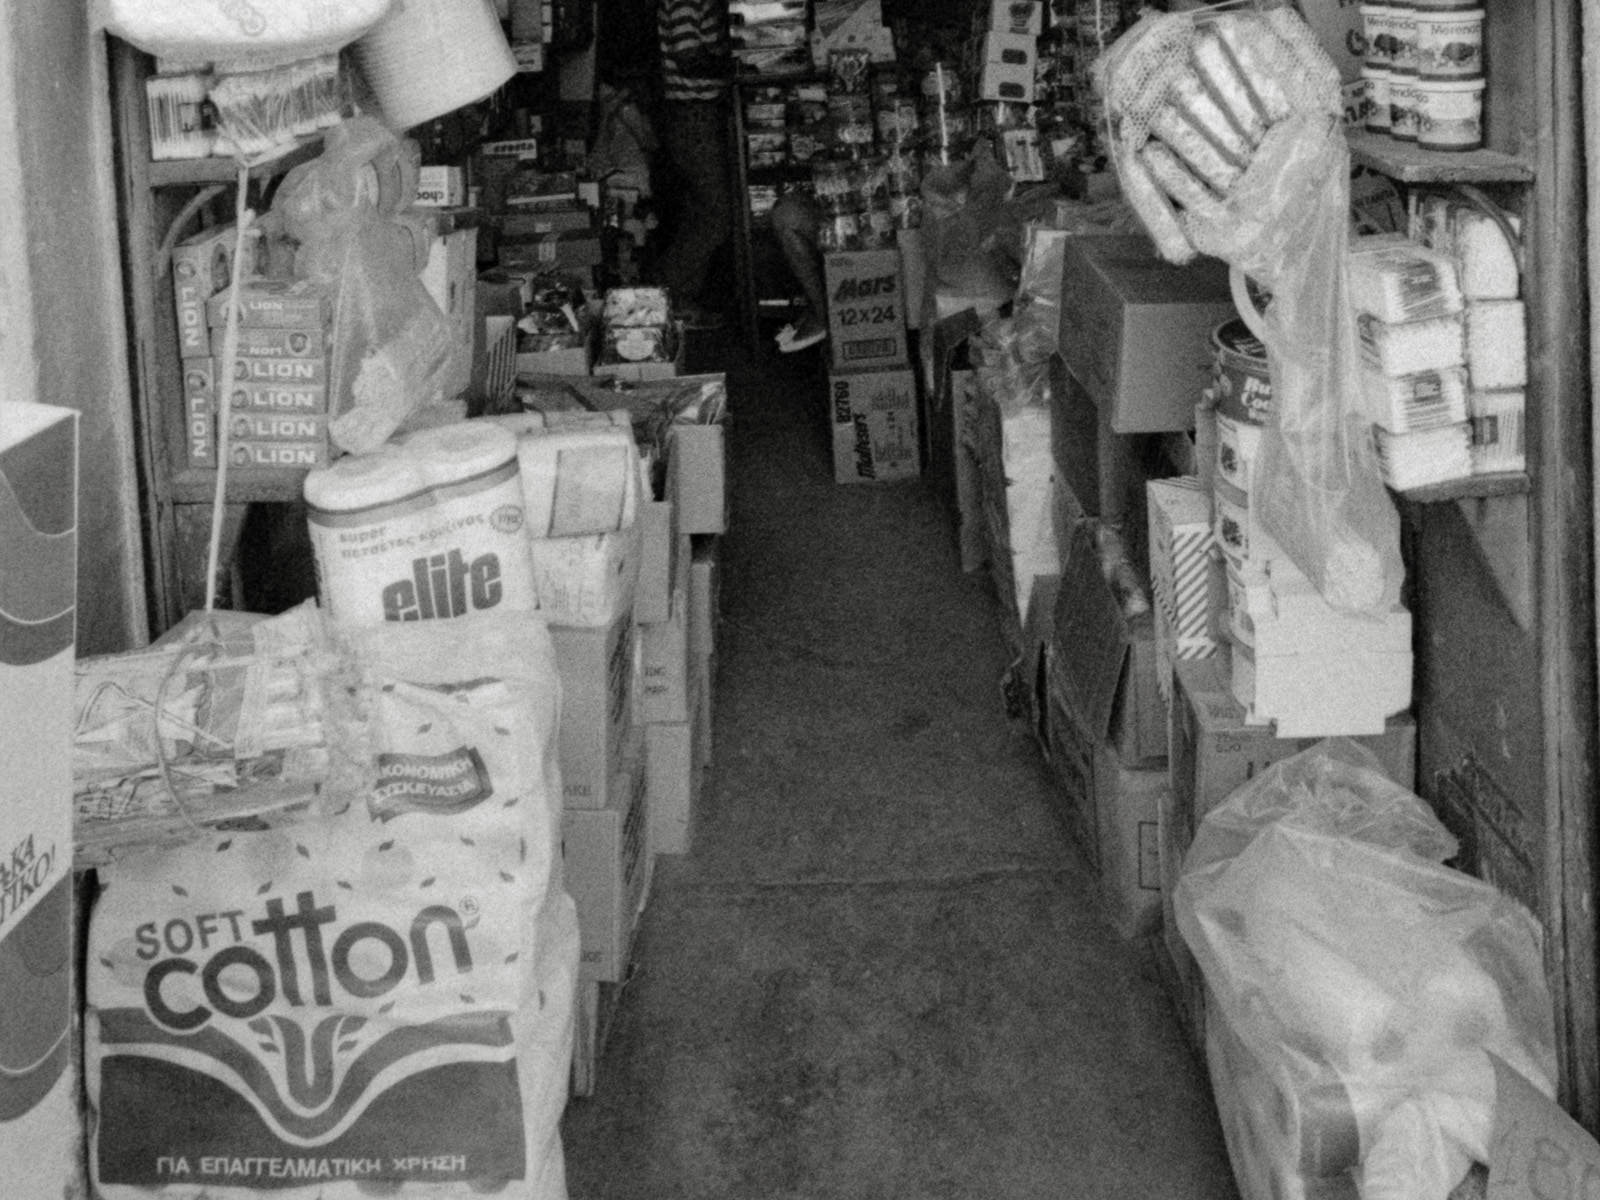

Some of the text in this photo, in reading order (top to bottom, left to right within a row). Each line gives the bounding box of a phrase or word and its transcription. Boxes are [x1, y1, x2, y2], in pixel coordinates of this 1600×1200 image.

[833, 275, 897, 300] Mars
[181, 286, 199, 347] LION
[250, 301, 283, 310] LION
[250, 346, 282, 355] LION
[254, 362, 313, 378] LION
[254, 392, 313, 407] LION
[191, 398, 207, 458] LION
[257, 421, 317, 437] LION
[257, 450, 317, 464] LION
[382, 548, 503, 622] elite
[135, 910, 245, 961] SOFT
[143, 890, 473, 1031] cotton
[156, 1154, 467, 1177] ΓΙΑ ΕΠΑΓΓΕΛΜΑΤΙΚΗ ΧΡΗΣΗ
